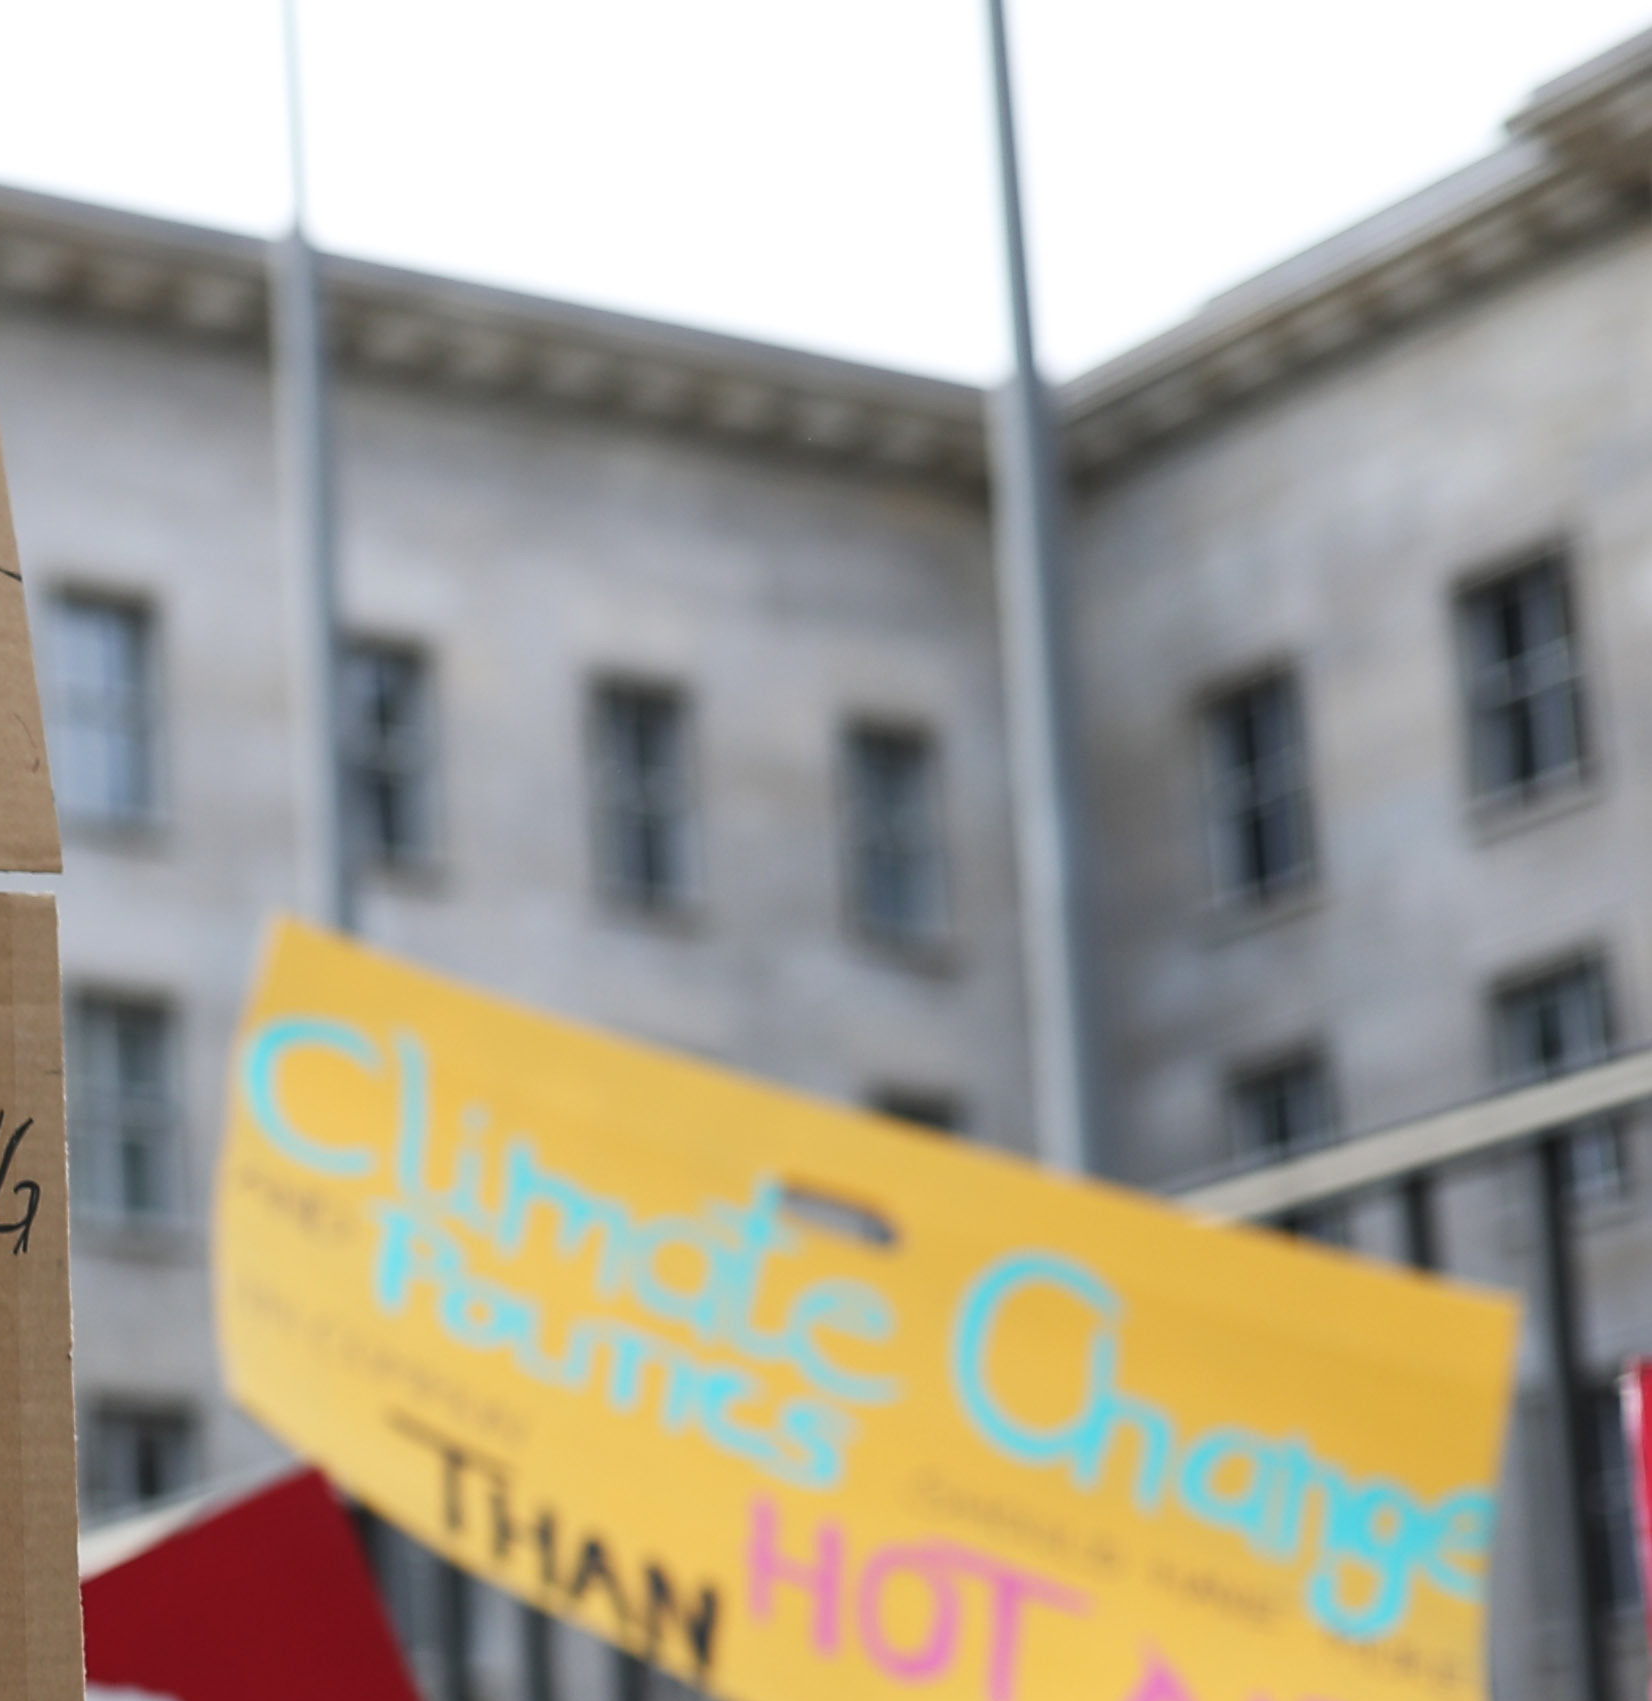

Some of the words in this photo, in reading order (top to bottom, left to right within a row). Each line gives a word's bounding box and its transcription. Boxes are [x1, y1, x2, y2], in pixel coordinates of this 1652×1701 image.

[242, 1015, 904, 1403] Climate
[949, 1248, 1498, 1643] Change
[383, 1404, 721, 1674] THAN
